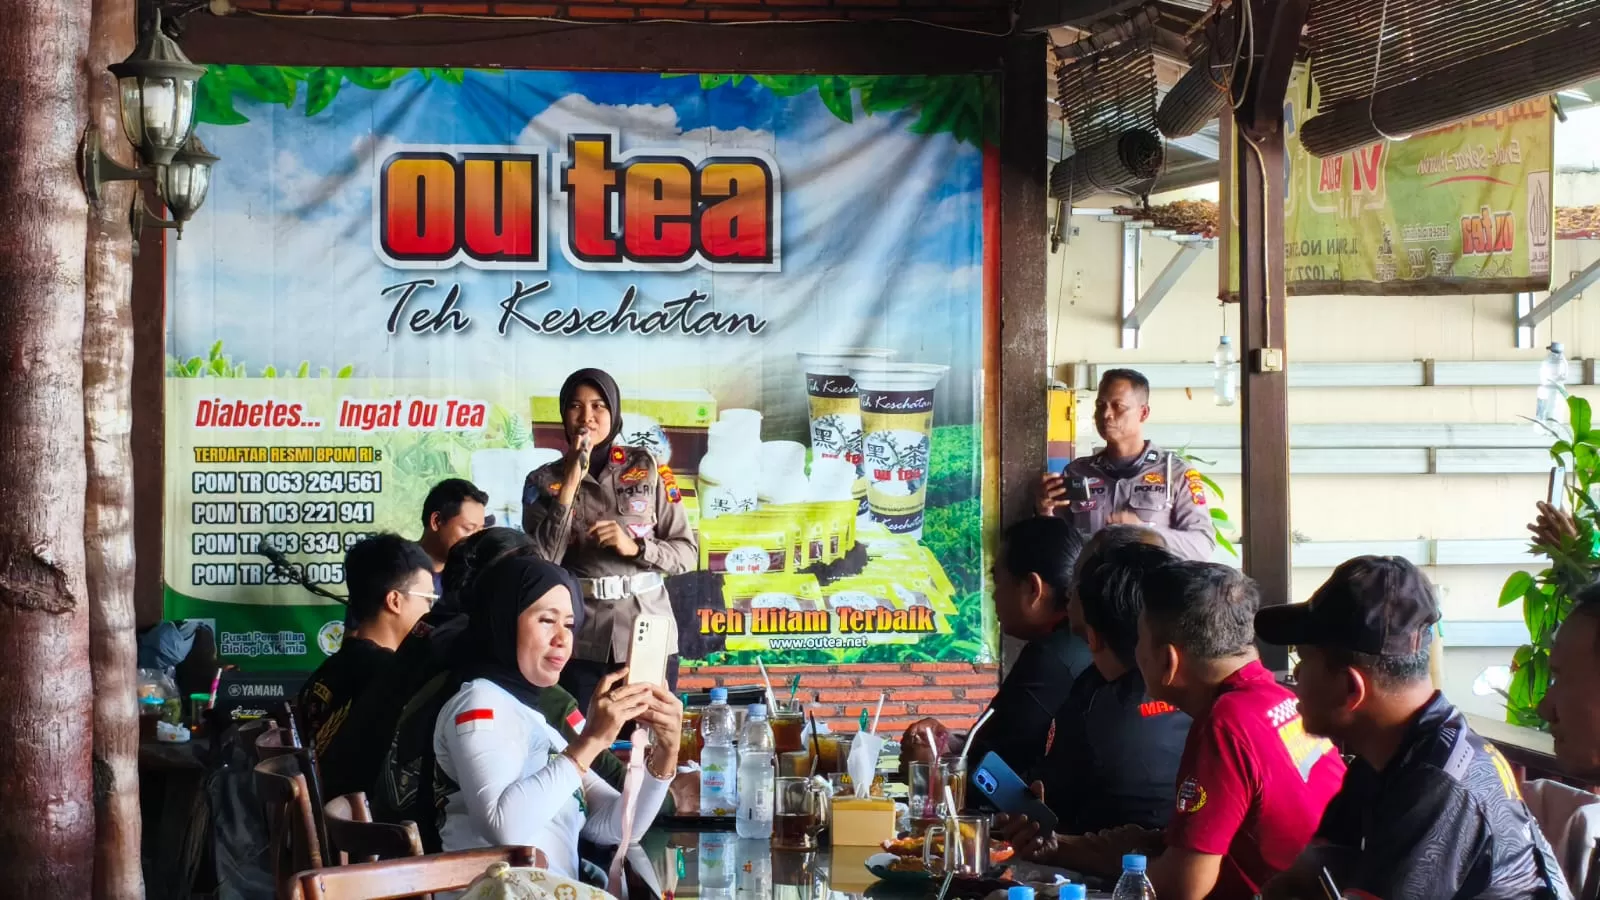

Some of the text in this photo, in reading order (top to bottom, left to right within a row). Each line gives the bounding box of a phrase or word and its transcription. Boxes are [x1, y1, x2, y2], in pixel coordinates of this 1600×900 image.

[379, 132, 775, 265] ou tea
[380, 279, 767, 335] Teh Kesehatan
[339, 400, 402, 431] Ingat
[407, 400, 438, 427] Ou
[445, 400, 486, 427] Tea
[194, 446, 268, 463] TERDAFTAR
[270, 446, 313, 463] RESMI
[315, 446, 356, 463] BPOM
[359, 446, 374, 462] RI
[192, 472, 382, 494] POM TR 063 264 561
[616, 484, 654, 497] POLRI
[1134, 485, 1166, 494] POLRI
[192, 502, 374, 524] POM TR 103 221 941
[192, 532, 237, 554] POM
[239, 532, 263, 554] TR
[302, 532, 341, 554] 334
[192, 564, 237, 585] POM
[239, 564, 263, 585] TR
[697, 604, 937, 635] Teh Hitam Terbaik
[221, 631, 306, 643] Pusat Penelitian
[769, 635, 869, 650] www.outea.net
[221, 643, 306, 657] Biologi & Kimia
[241, 684, 285, 697] YAMAHA
